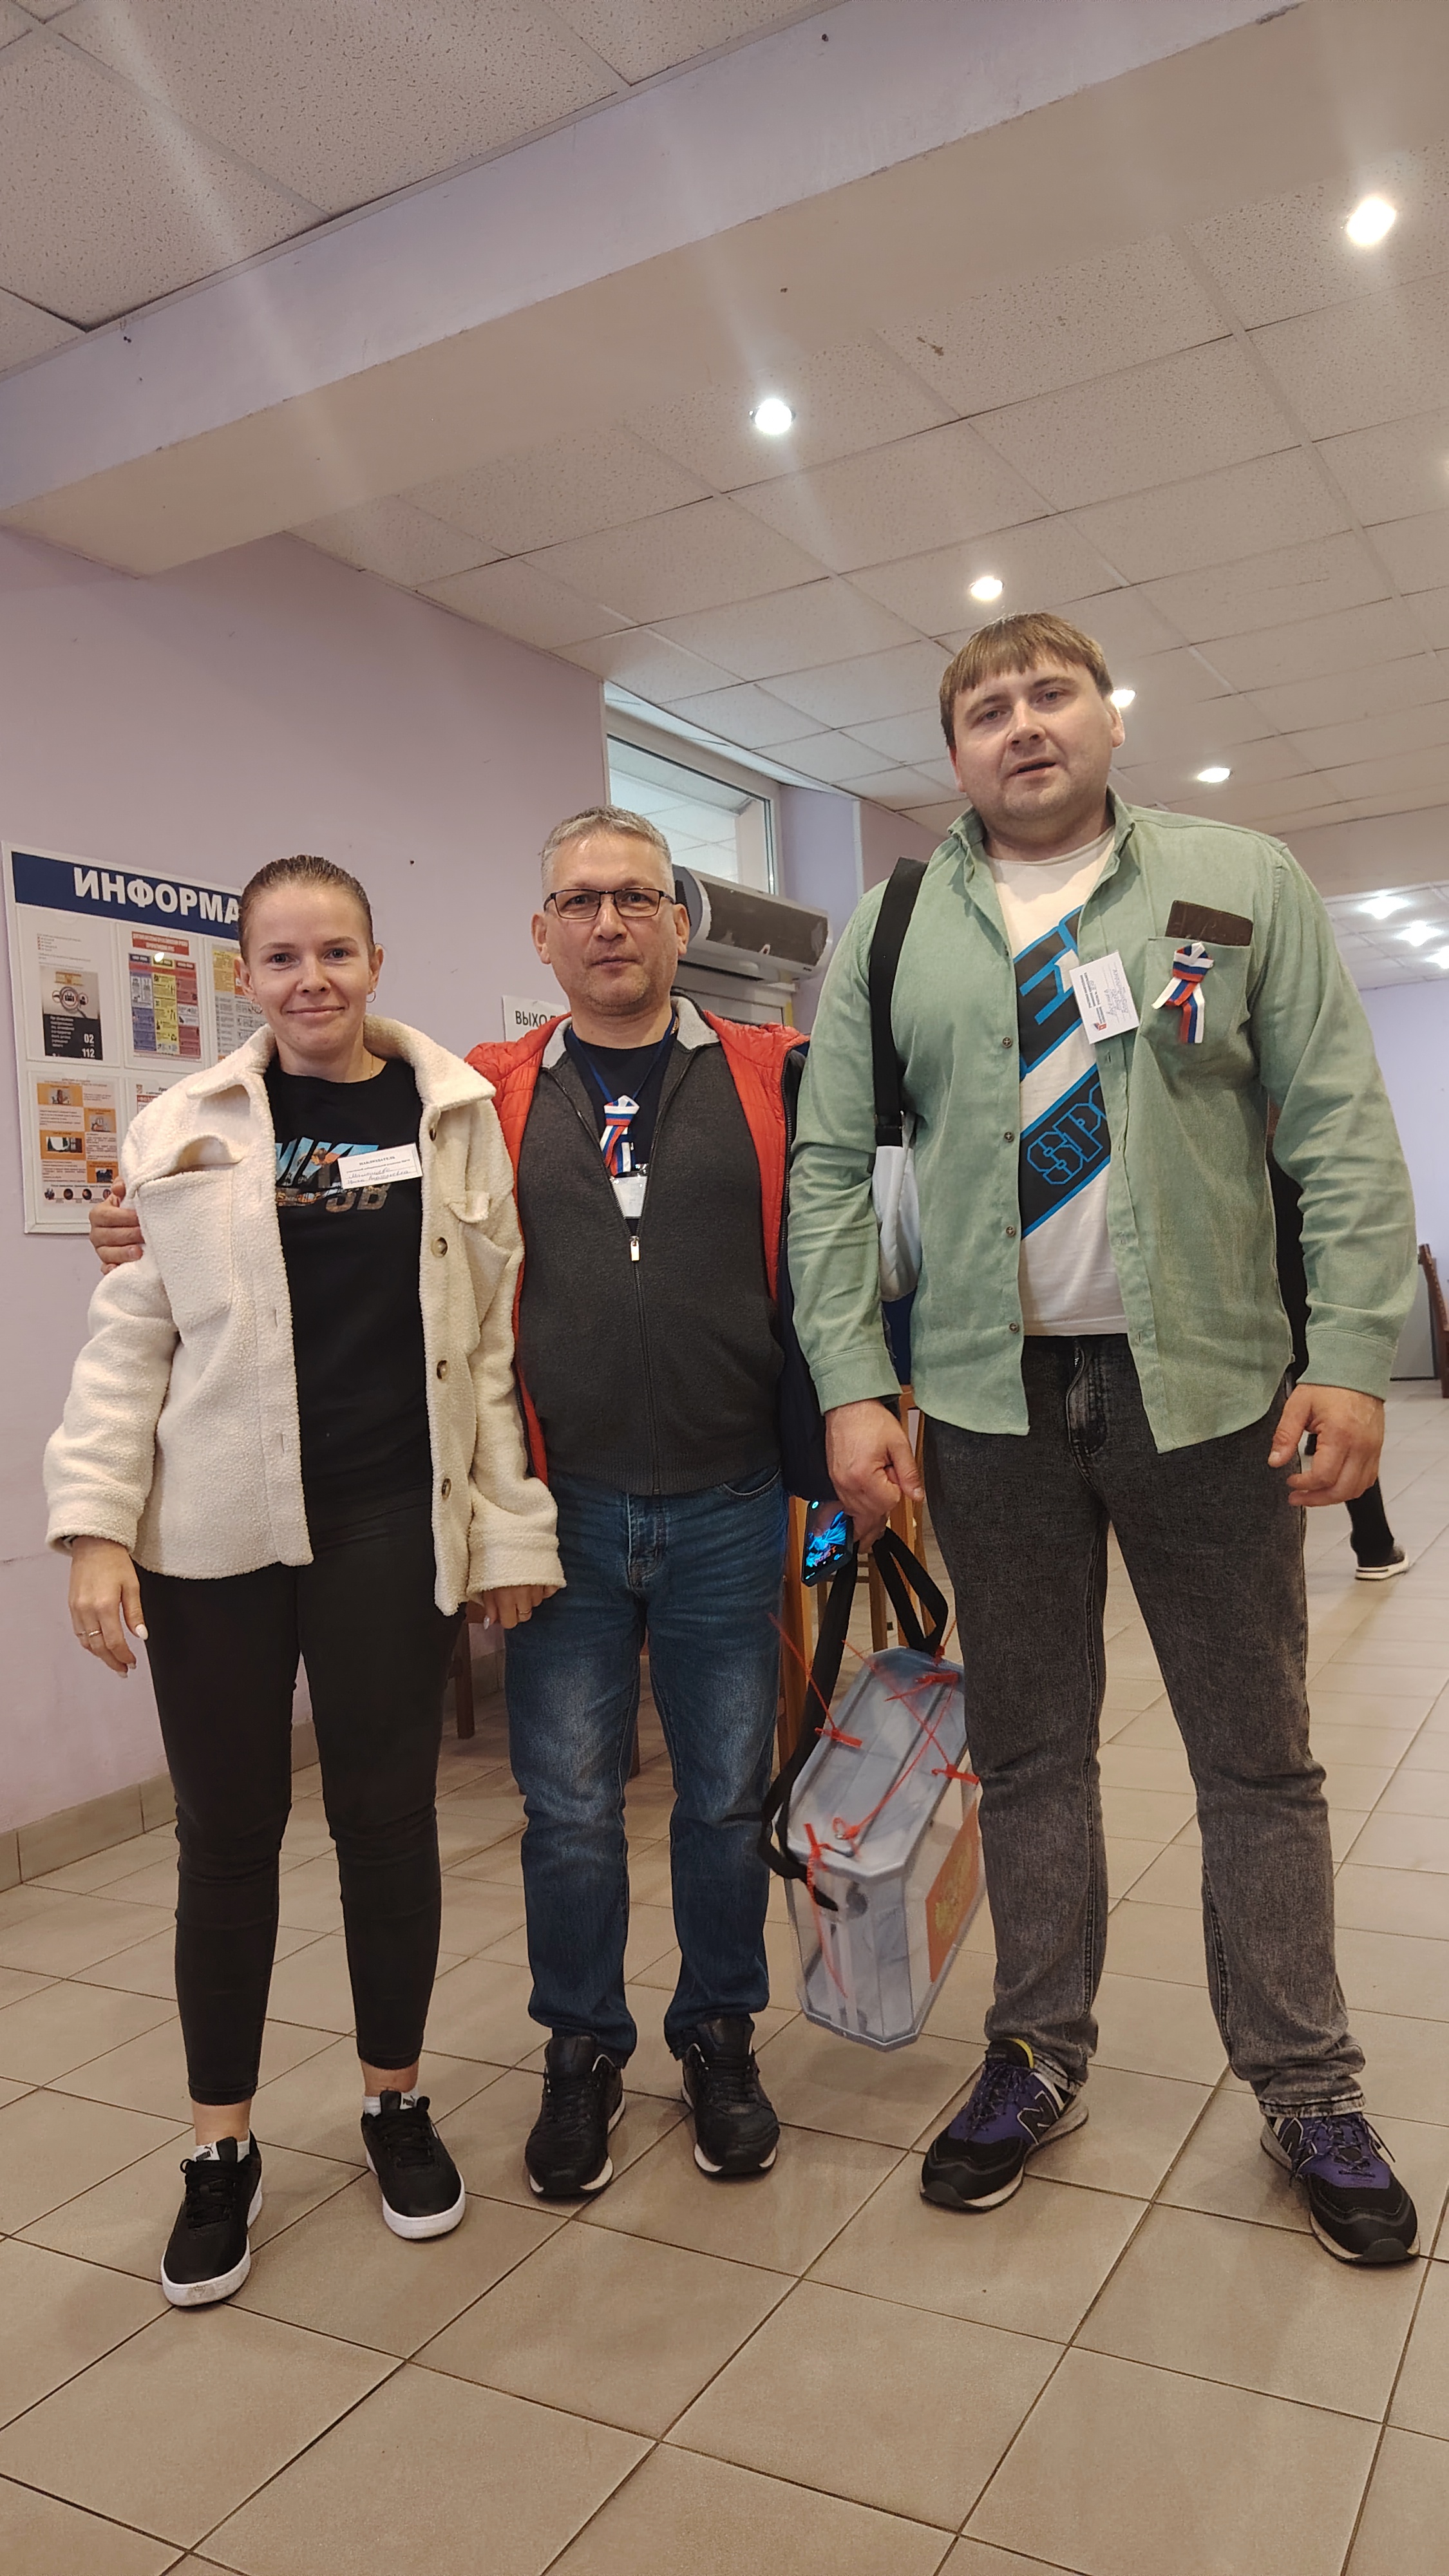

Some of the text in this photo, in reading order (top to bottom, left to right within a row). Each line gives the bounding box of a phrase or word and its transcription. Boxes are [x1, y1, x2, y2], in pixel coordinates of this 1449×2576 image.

[515, 1010, 556, 1027] ВЫХО
[84, 1033, 95, 1044] 02
[82, 1048, 95, 1058] 112
